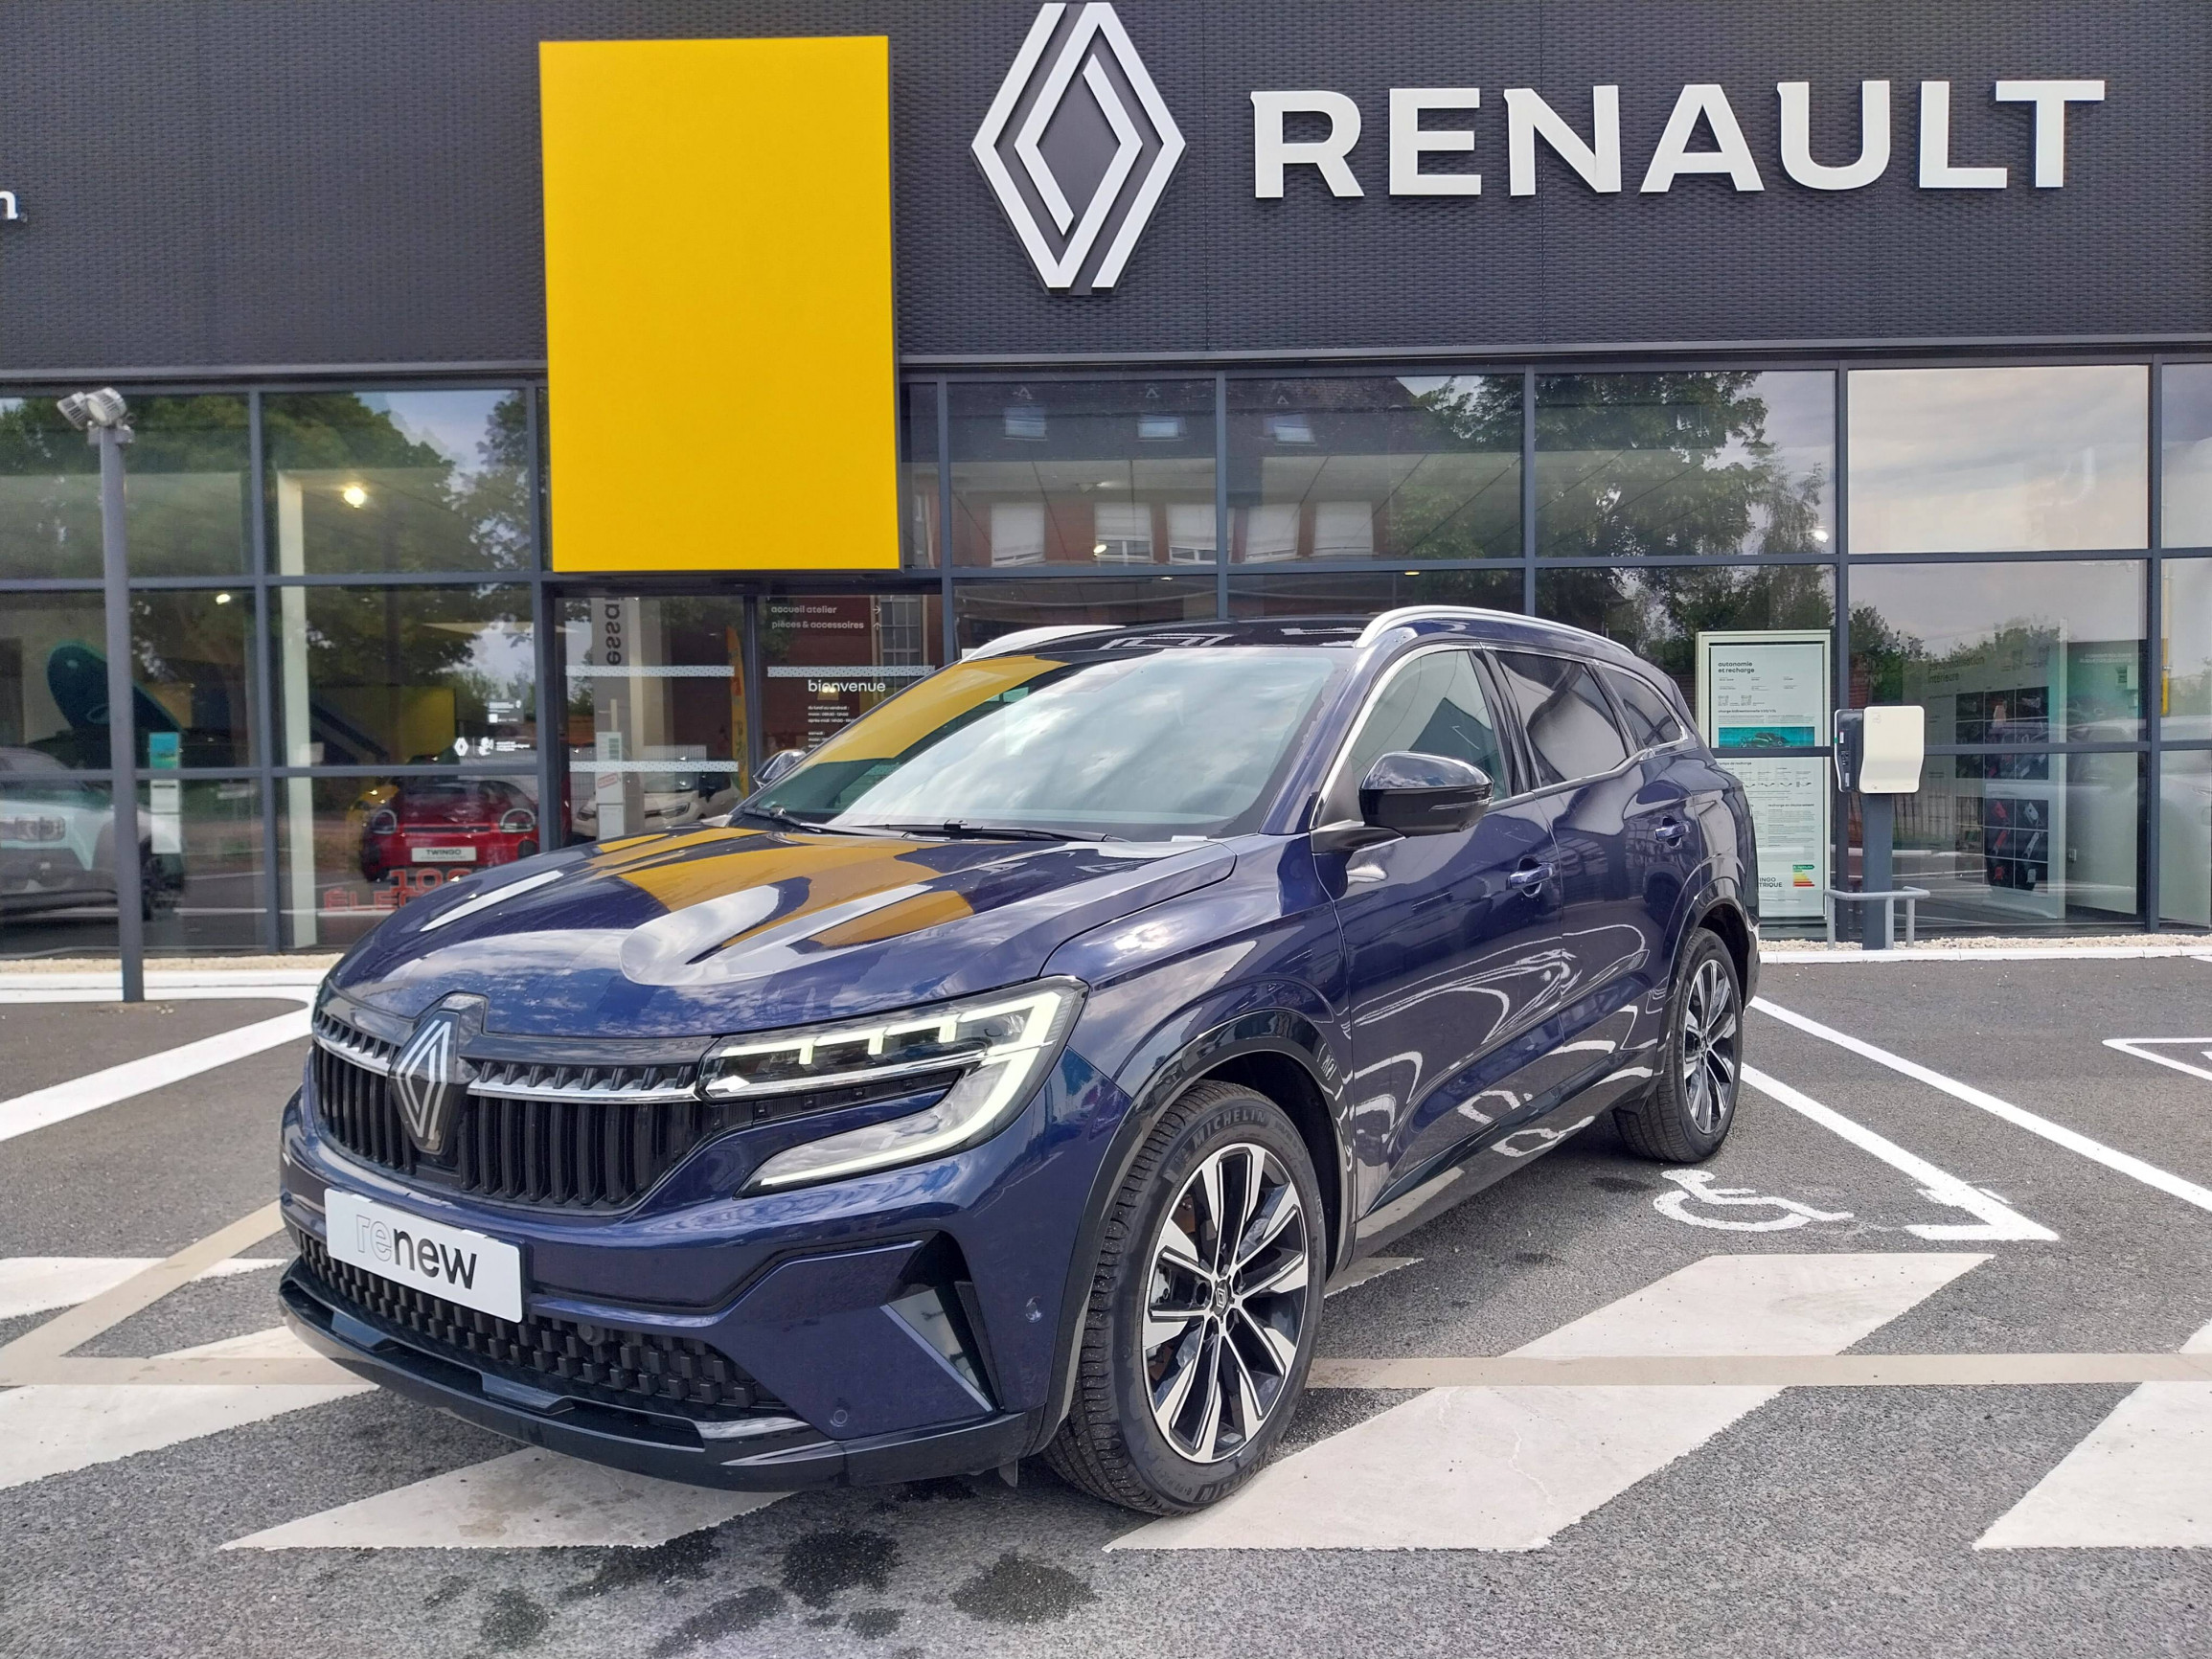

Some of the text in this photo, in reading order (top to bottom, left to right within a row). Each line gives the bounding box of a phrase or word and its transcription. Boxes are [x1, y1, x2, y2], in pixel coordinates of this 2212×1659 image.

[1250, 80, 2106, 197] RENAULT
[771, 620, 801, 629] pièces
[810, 621, 864, 629] accessoires
[808, 679, 886, 693] bienvenue
[1192, 1108, 1266, 1148] MICHELIN
[356, 1215, 477, 1289] renew
